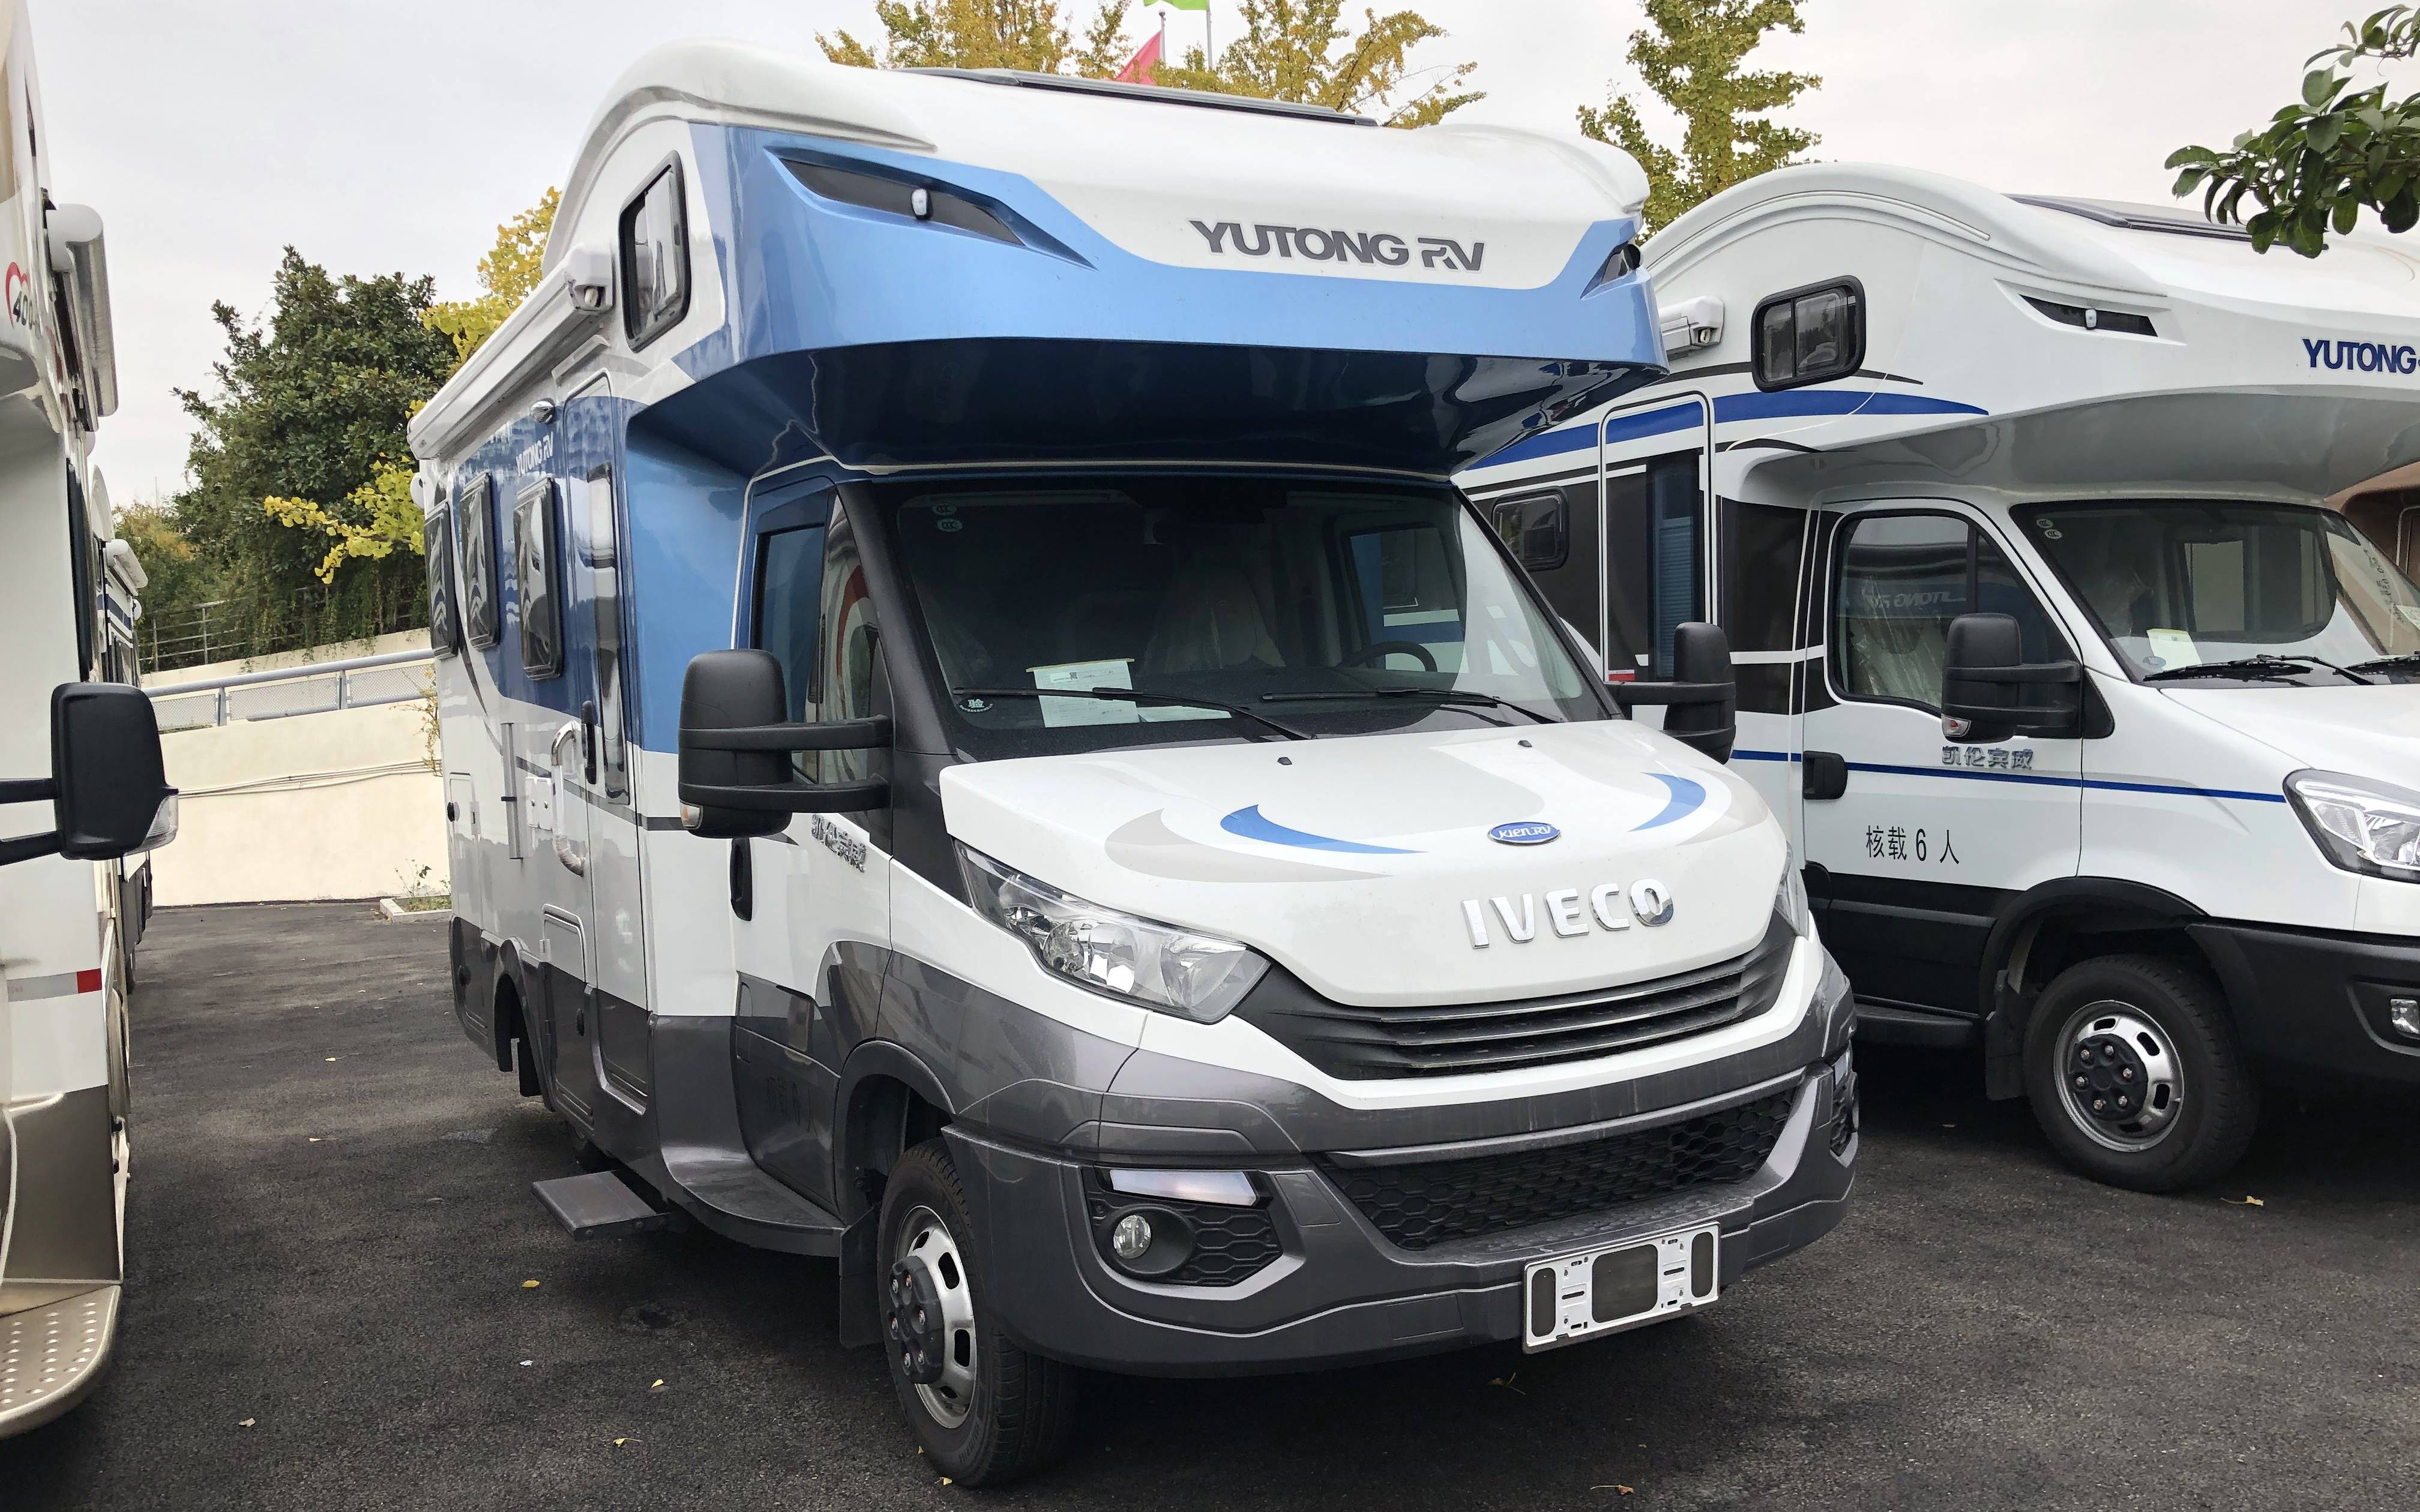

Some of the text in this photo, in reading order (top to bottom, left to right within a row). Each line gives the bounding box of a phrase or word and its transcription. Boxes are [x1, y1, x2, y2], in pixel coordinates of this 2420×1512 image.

[1189, 220, 1484, 271] YUTONG RV
[2302, 338, 2416, 374] YUTONG
[516, 440, 542, 477] YUTONG
[1461, 878, 1674, 949] IVECO
